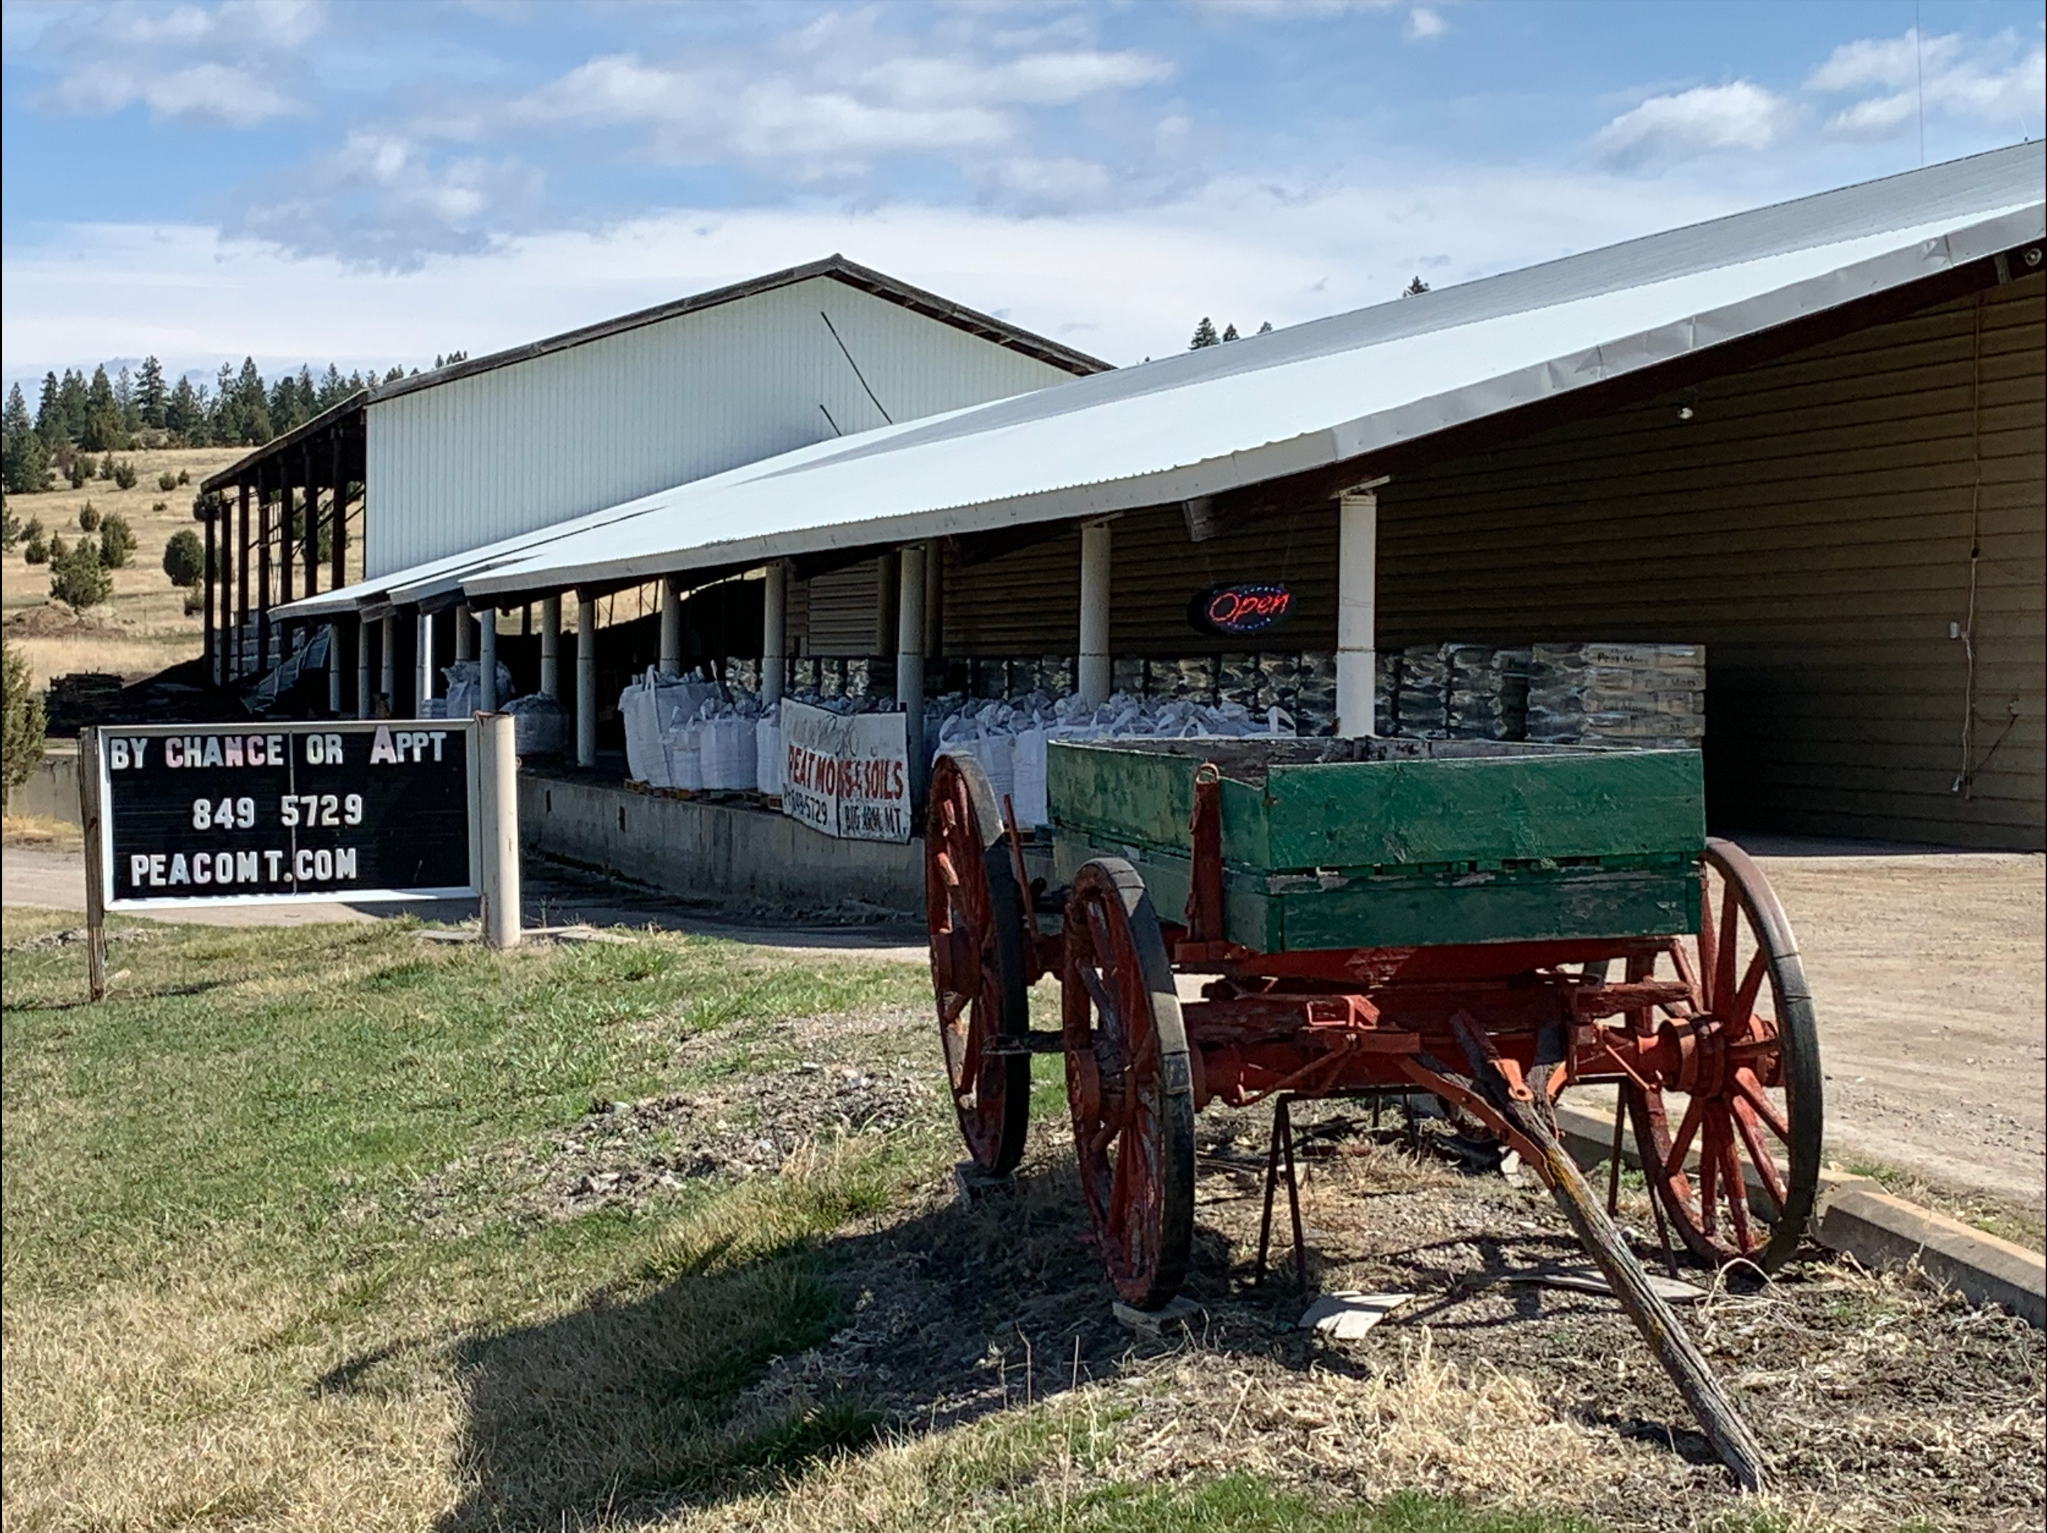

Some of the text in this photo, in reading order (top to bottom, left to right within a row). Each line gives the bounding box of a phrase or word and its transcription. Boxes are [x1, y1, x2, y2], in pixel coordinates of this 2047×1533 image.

[1209, 592, 1290, 623] Open
[110, 725, 447, 770] BY CHANCE OR APPT
[788, 743, 816, 788] PEAT
[863, 758, 904, 800] SOILS
[192, 794, 363, 830] 849 5729
[130, 848, 357, 887] PEACOMT.COM
